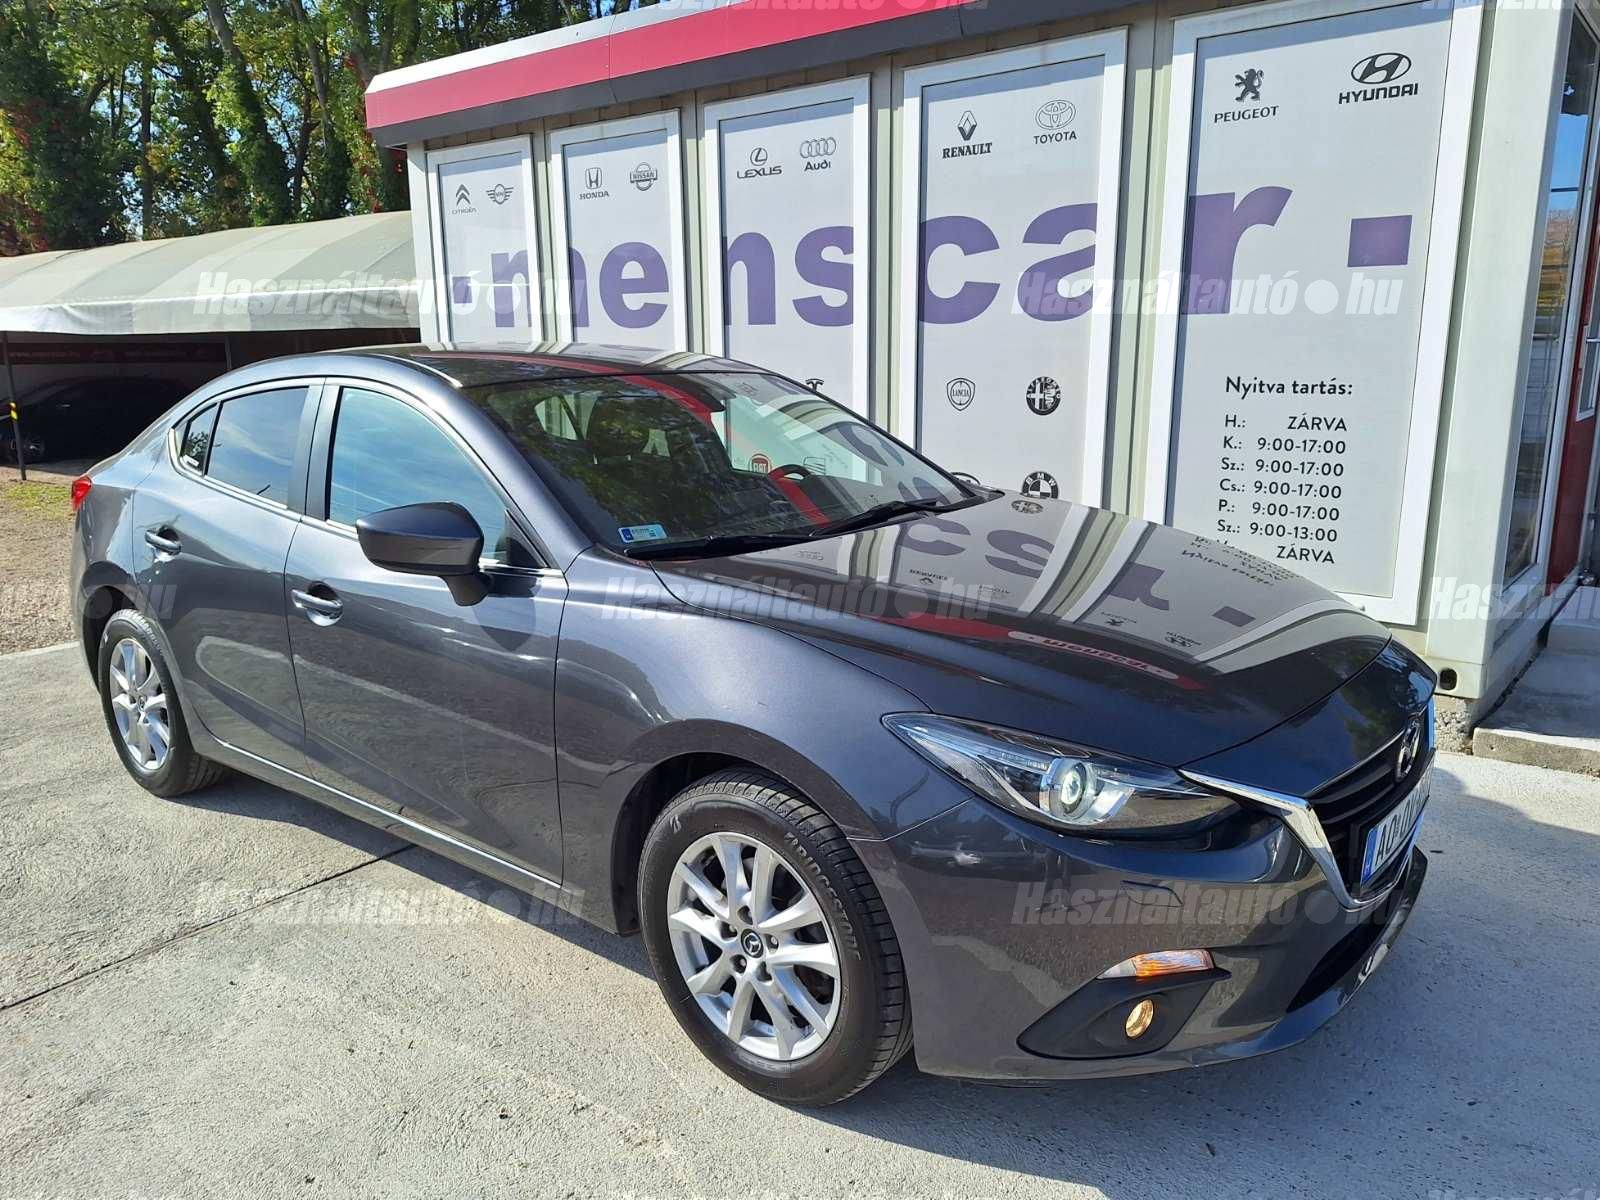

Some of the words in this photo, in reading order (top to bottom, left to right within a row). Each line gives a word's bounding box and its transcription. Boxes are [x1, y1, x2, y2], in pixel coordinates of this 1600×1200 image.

[1338, 83, 1419, 104] HYUNDAI
[1214, 105, 1280, 123] PEUGEOT
[1033, 130, 1078, 145] TOYOTA
[942, 142, 993, 159] RENAULT
[736, 166, 783, 179] LEXUS
[804, 160, 832, 172] Audi
[578, 190, 610, 200] HONDA
[1225, 376, 1285, 399] Nyitva
[1292, 378, 1353, 395] tartás:
[1224, 414, 1247, 428] H.:
[1287, 412, 1347, 432] ZÁRVA
[1223, 436, 1242, 449] K.:
[1257, 437, 1346, 454] 9:00-17:00
[1221, 457, 1245, 471] Sz.:
[1255, 459, 1344, 477] 9:00-17:00
[1219, 479, 1245, 493] Cs.:
[1253, 480, 1342, 499] 9:00-17:00
[1218, 499, 1235, 513] P.:
[1252, 502, 1340, 521] 9:00-17:00
[1217, 520, 1240, 534] Sz.:
[1249, 522, 1338, 542] 9:00-13:00
[1276, 543, 1335, 564] ZÁRVA
